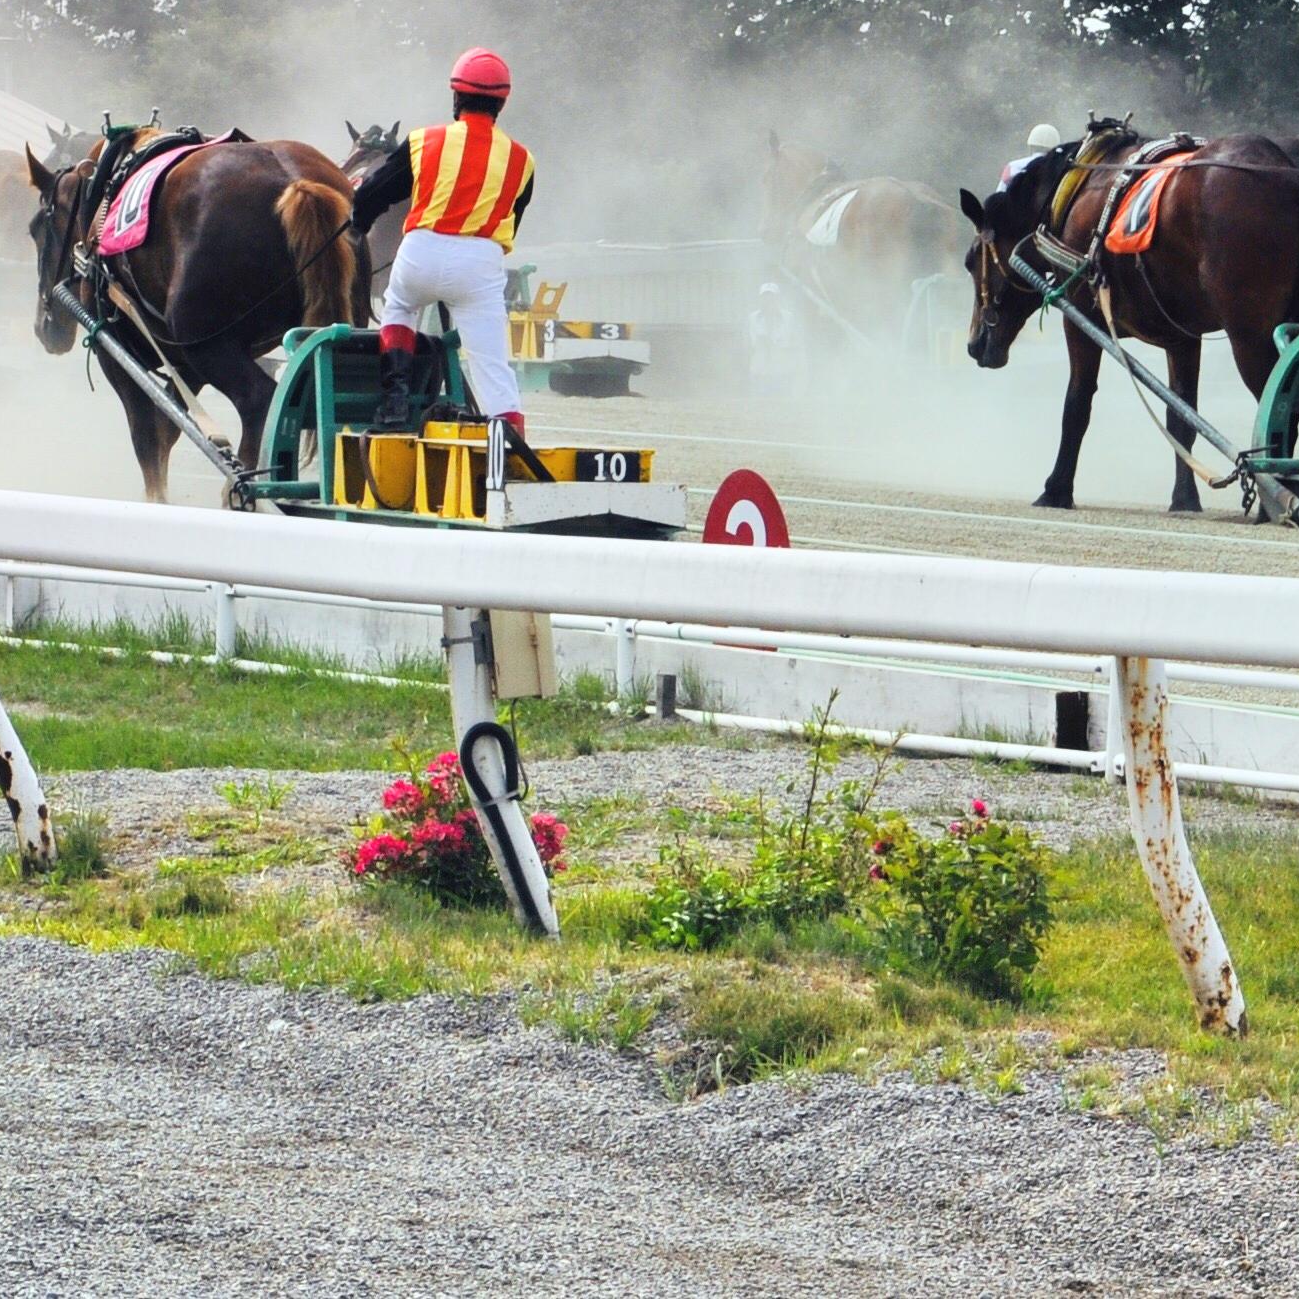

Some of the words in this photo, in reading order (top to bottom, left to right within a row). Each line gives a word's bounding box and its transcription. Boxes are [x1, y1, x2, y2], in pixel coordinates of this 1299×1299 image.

[544, 319, 555, 342] 3
[600, 323, 619, 339] 3
[486, 418, 504, 490] 10
[593, 452, 627, 482] 10
